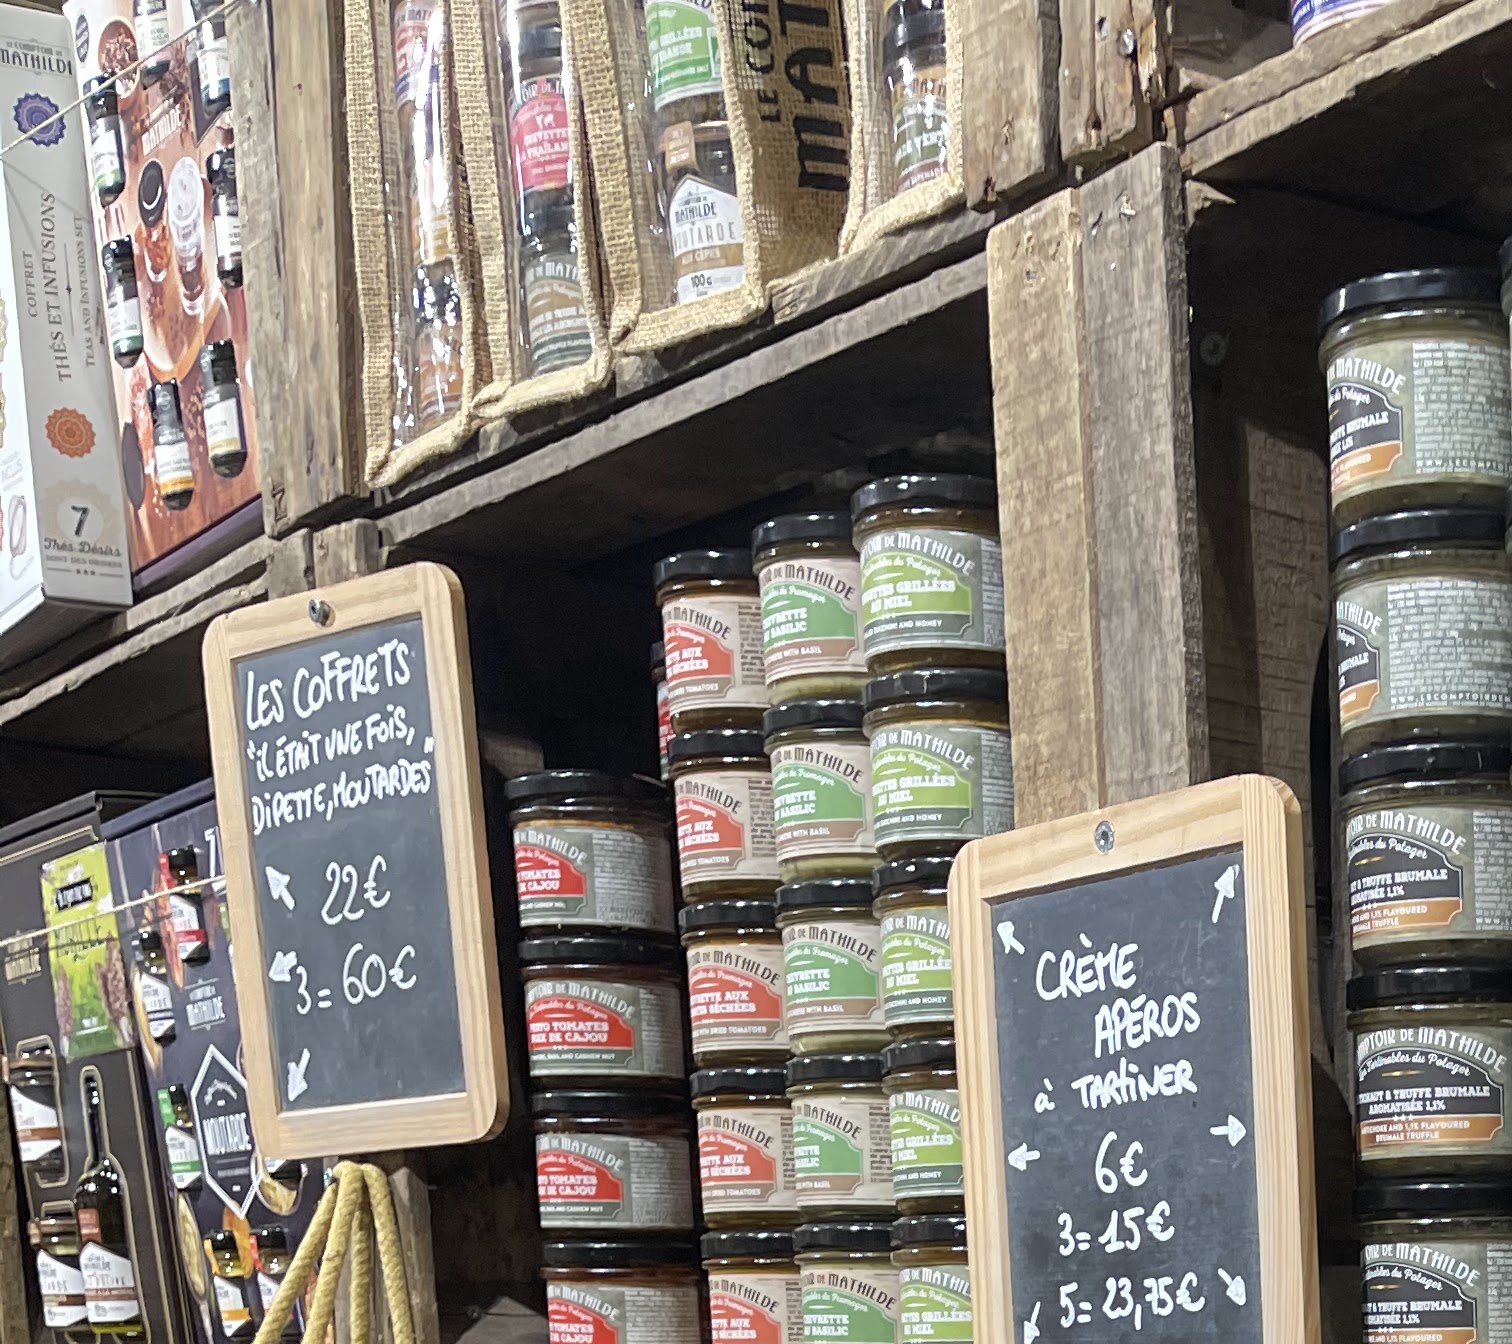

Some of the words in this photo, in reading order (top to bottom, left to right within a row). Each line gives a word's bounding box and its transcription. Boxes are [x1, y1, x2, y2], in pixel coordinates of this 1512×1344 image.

[759, 89, 781, 124] LE
[41, 192, 59, 296] INFUSIONS
[22, 250, 38, 318] COFFRET
[46, 299, 62, 325] ET
[49, 330, 71, 381] THÉS
[71, 506, 90, 537] 7
[898, 533, 975, 576] MATHILDE
[246, 671, 284, 730] LES
[292, 639, 410, 718] COFFRETS
[325, 720, 363, 761] UNE
[321, 855, 391, 925] 22€
[809, 926, 877, 962] MATHILDE
[1036, 933, 1139, 1001] CRÈME
[569, 982, 636, 1020] MATHILDE
[1094, 992, 1200, 1058] APÉROS
[1418, 1027, 1507, 1073] MATHILDE
[1095, 1131, 1148, 1193] 6€
